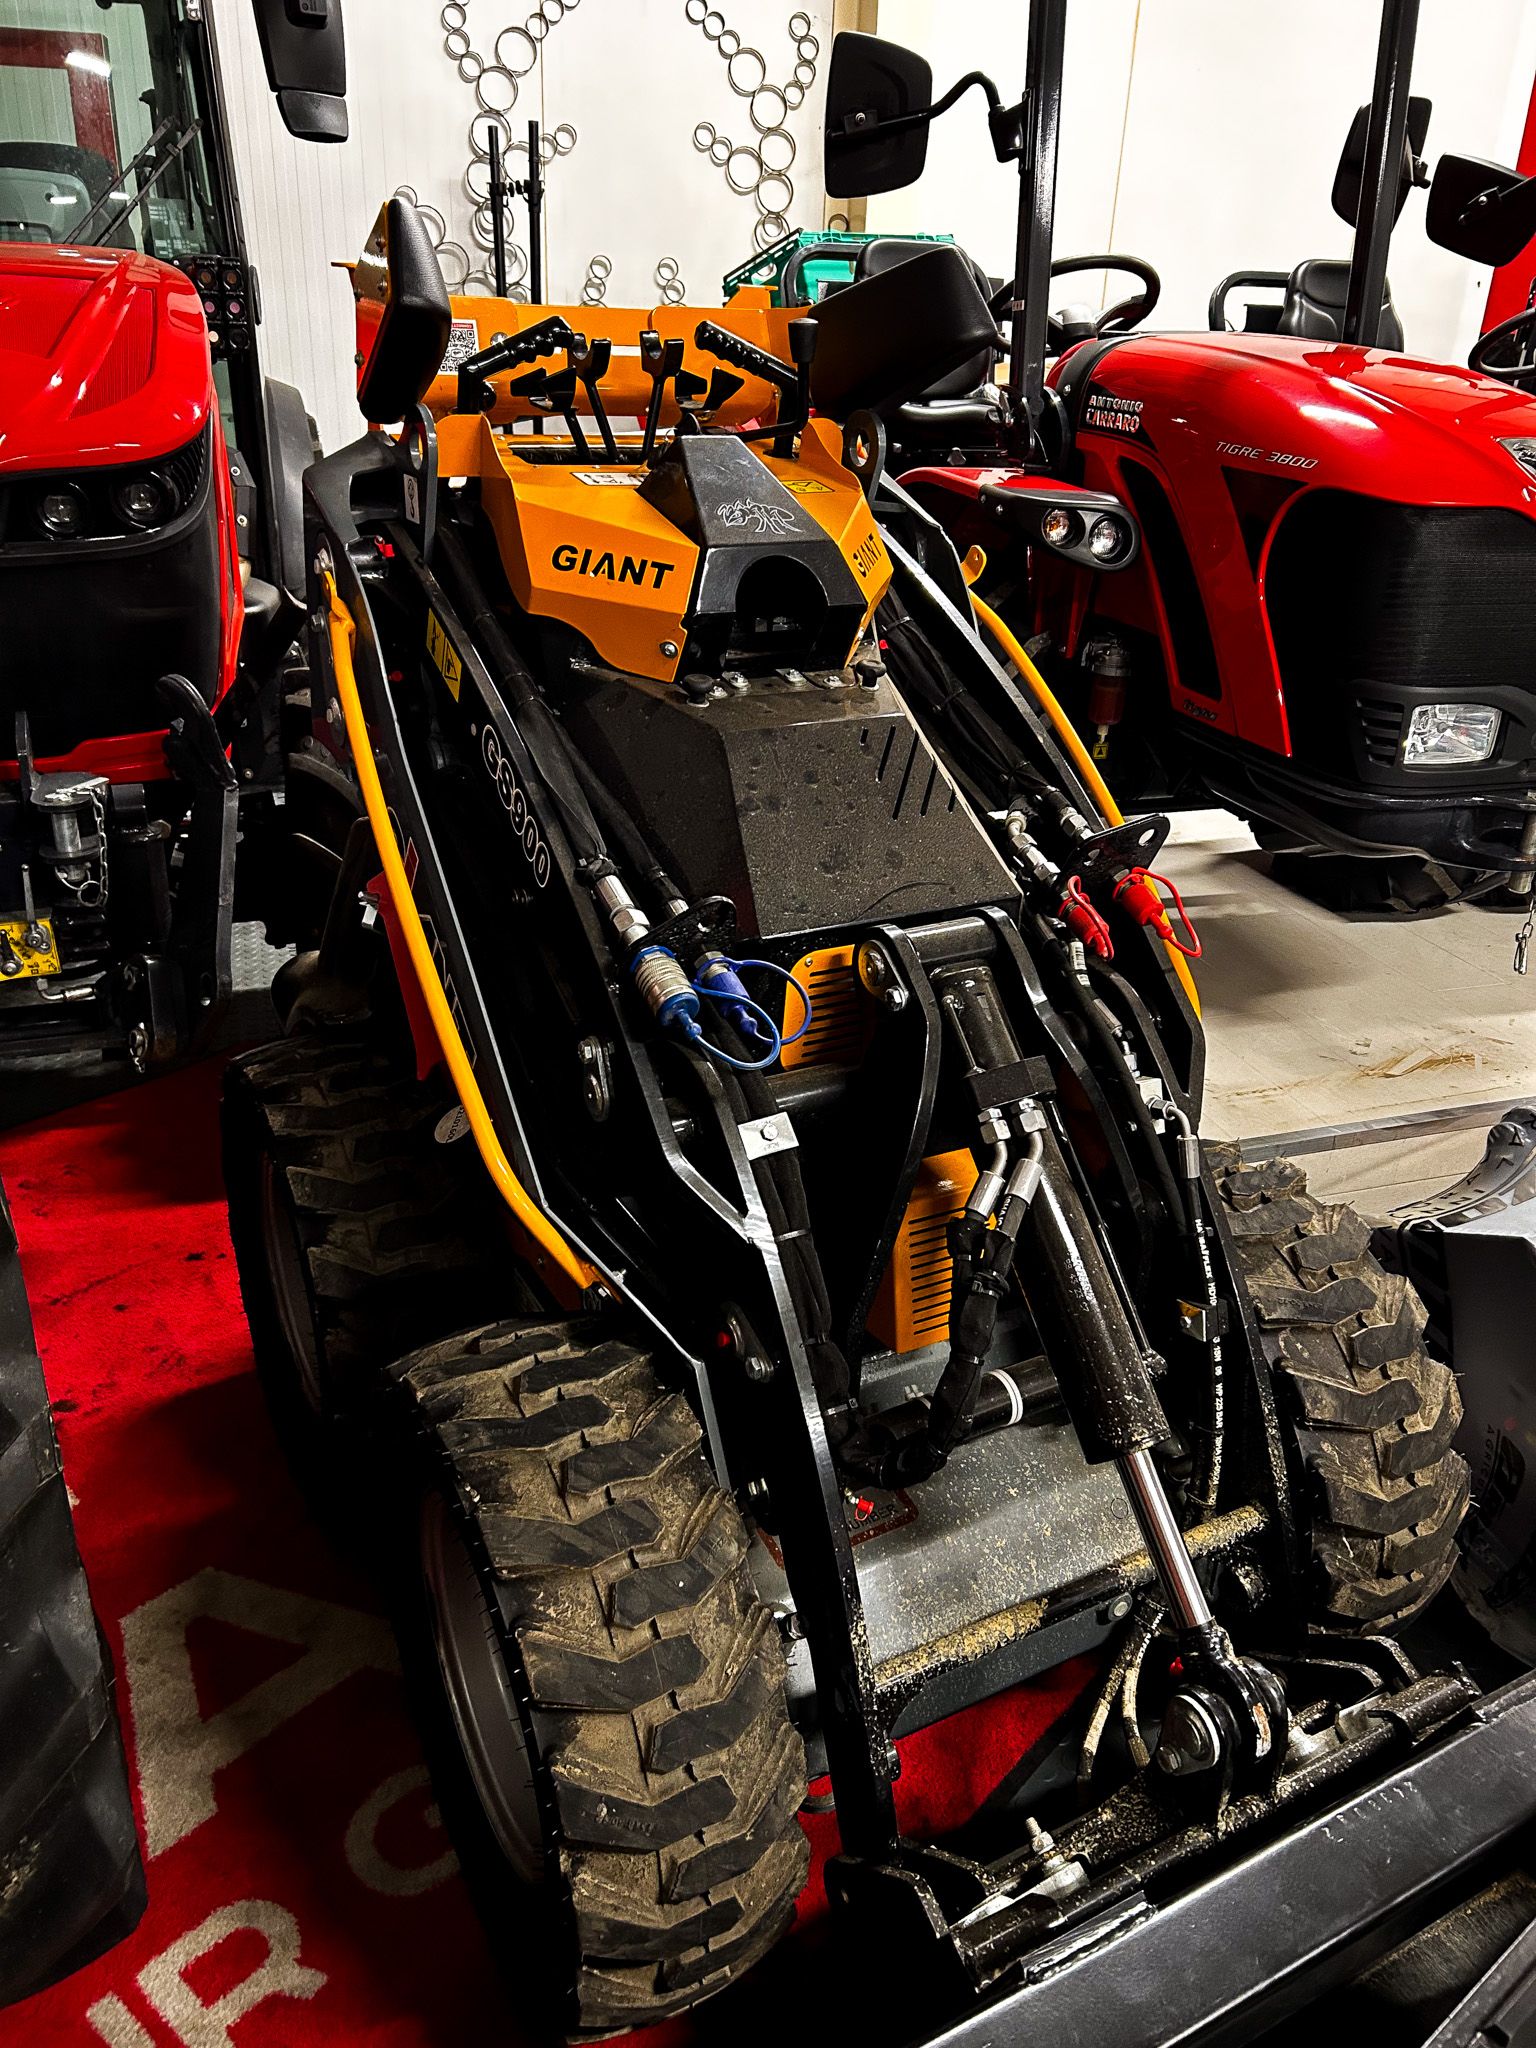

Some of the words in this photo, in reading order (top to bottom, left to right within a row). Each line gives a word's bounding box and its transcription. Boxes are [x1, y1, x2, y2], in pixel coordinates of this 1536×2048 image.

[1089, 395, 1144, 412] ANTONIO
[1086, 408, 1140, 433] CARRARO
[1216, 441, 1264, 459] TIGRE
[1265, 451, 1319, 469] 3800
[551, 544, 675, 589] GIANT
[853, 533, 882, 578] GIANT
